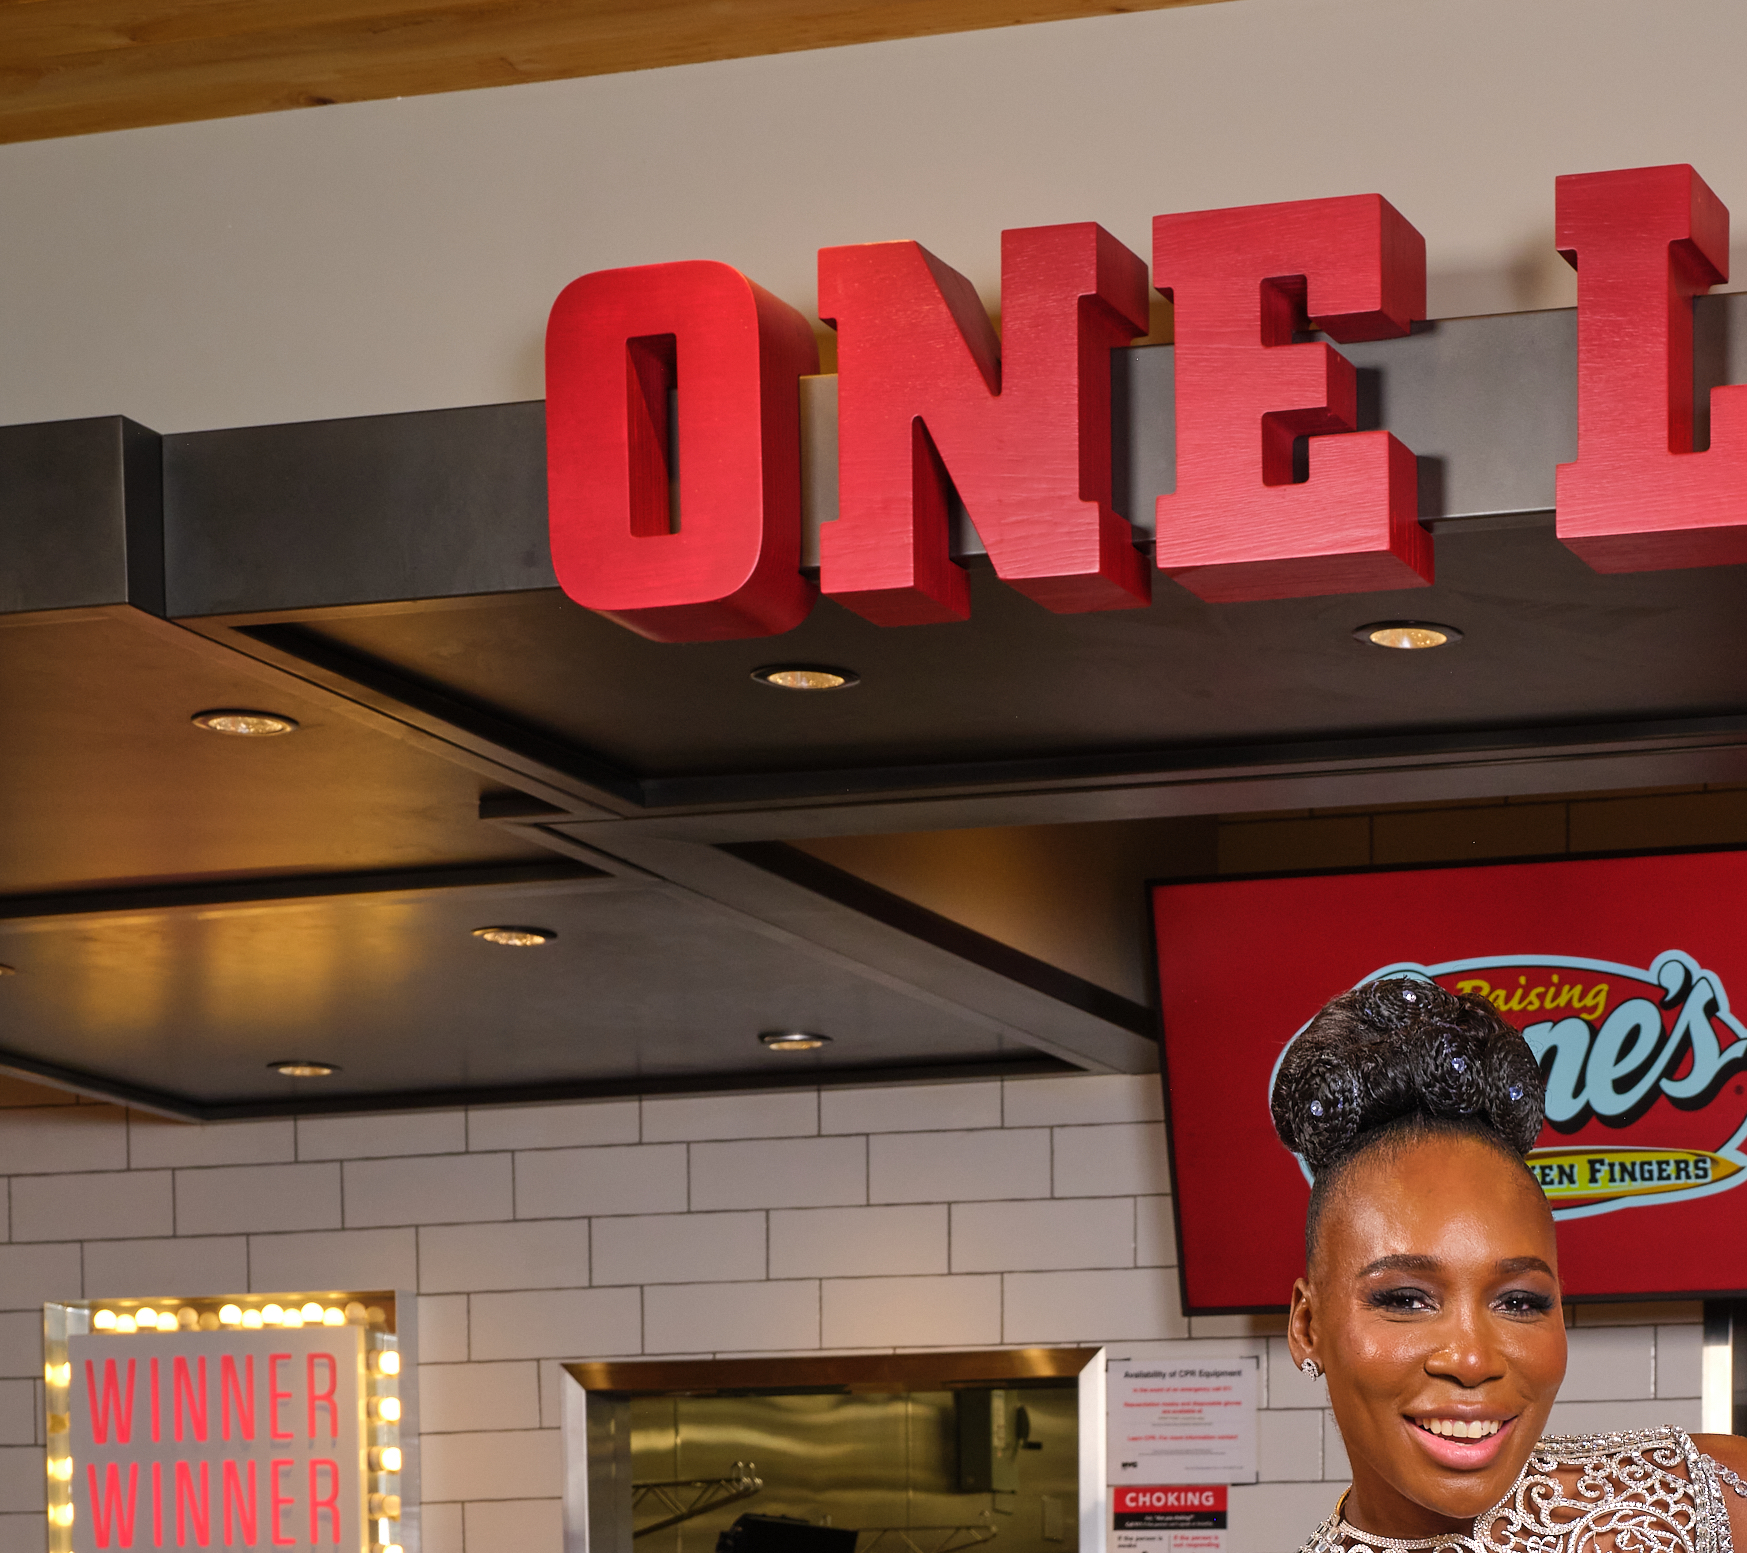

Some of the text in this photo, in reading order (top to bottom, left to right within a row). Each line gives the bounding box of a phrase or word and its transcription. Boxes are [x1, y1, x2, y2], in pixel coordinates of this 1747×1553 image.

[545, 191, 1435, 642] ONE
[1588, 1157, 1709, 1184] FINGERS
[85, 1352, 338, 1444] WINNER
[87, 1458, 341, 1548] WINNER
[1125, 1492, 1214, 1507] CHOKING
